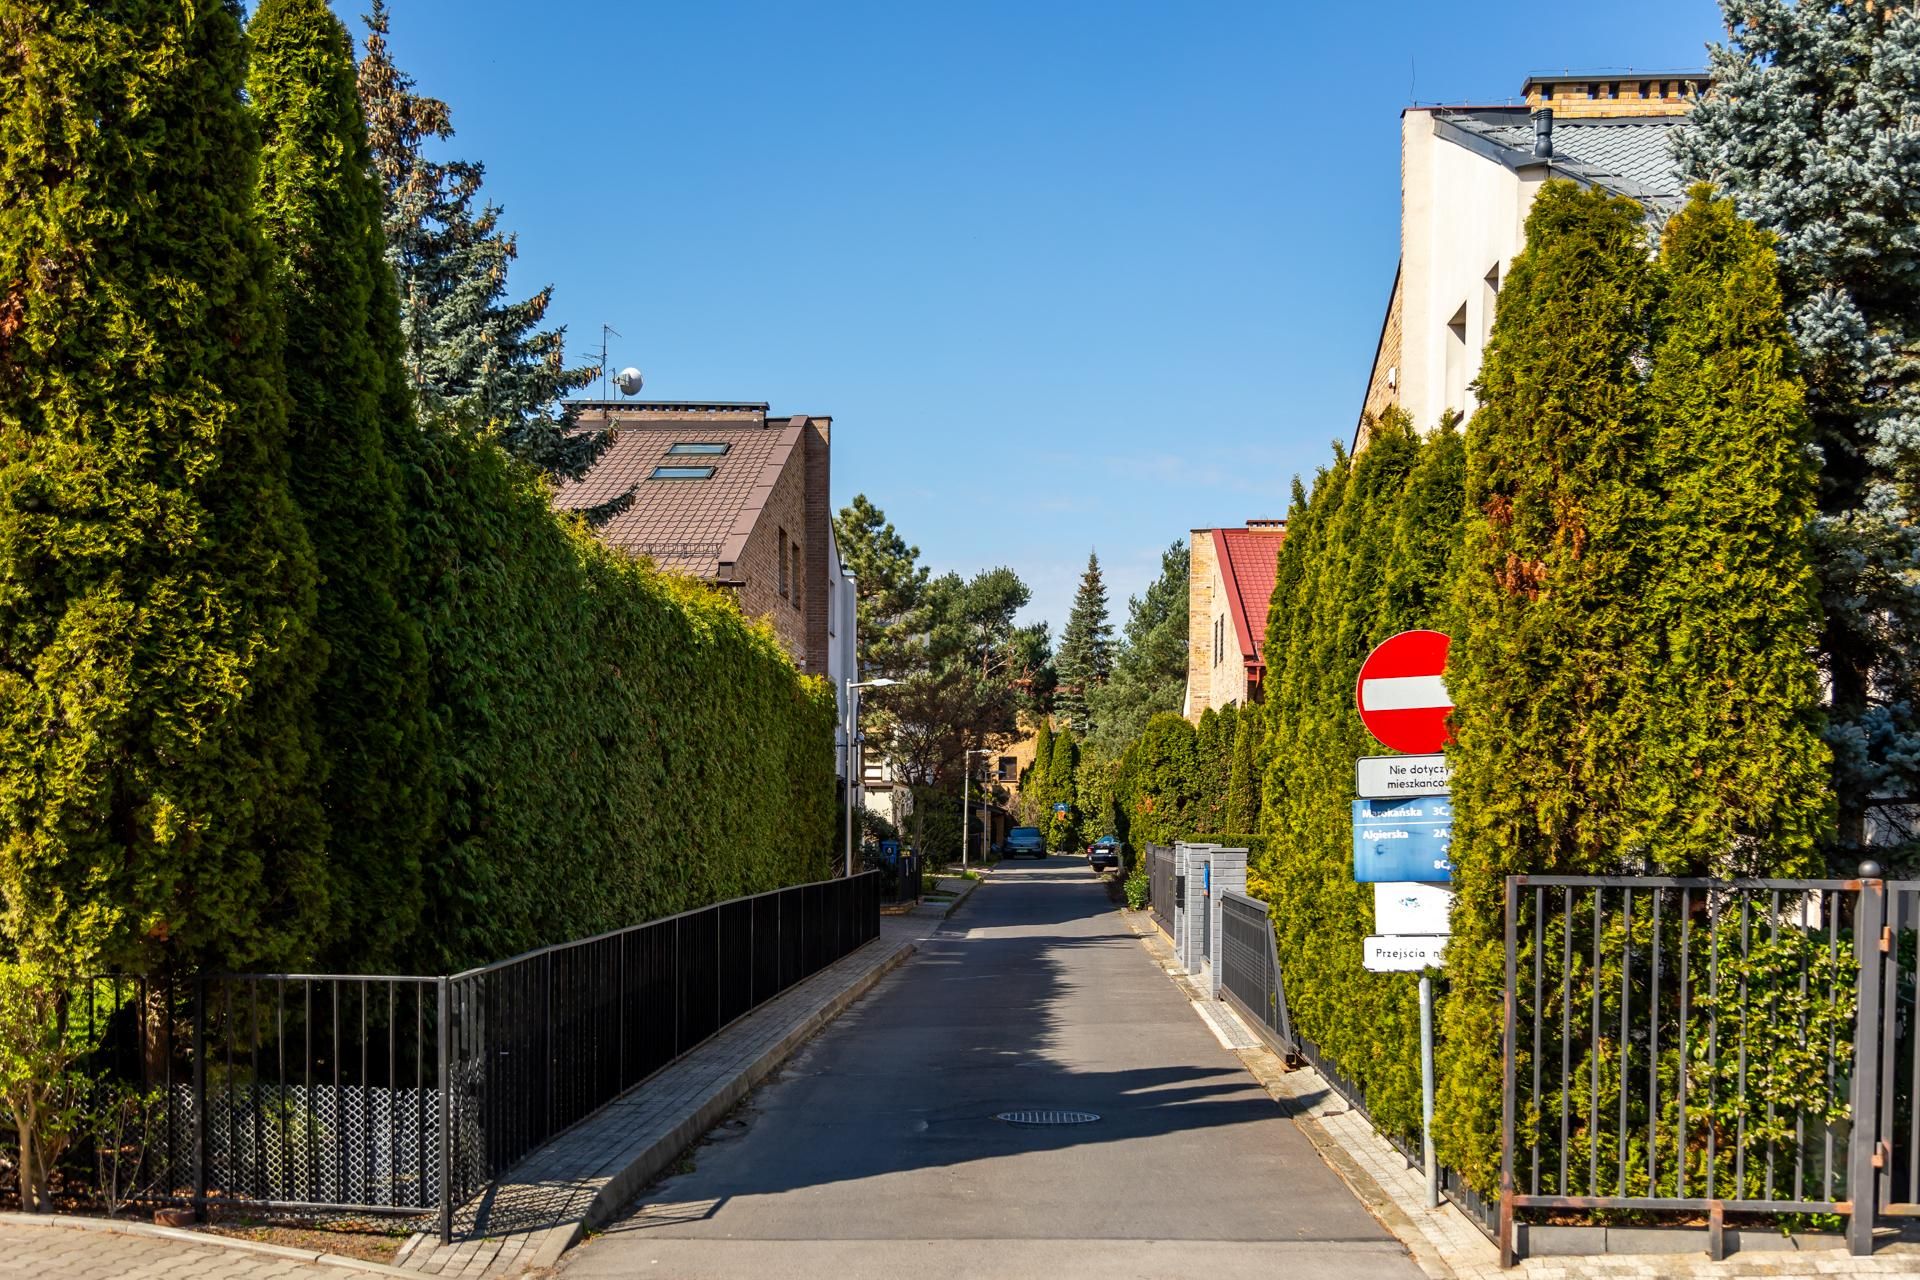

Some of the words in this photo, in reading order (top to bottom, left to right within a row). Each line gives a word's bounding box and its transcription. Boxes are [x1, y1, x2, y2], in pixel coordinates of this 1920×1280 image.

[1389, 765, 1406, 774] Nie
[1410, 764, 1449, 775] dotyczy
[1387, 778, 1448, 788] mieszkańcó
[1362, 830, 1408, 841] Algierska
[1376, 948, 1425, 959] Przejścia
